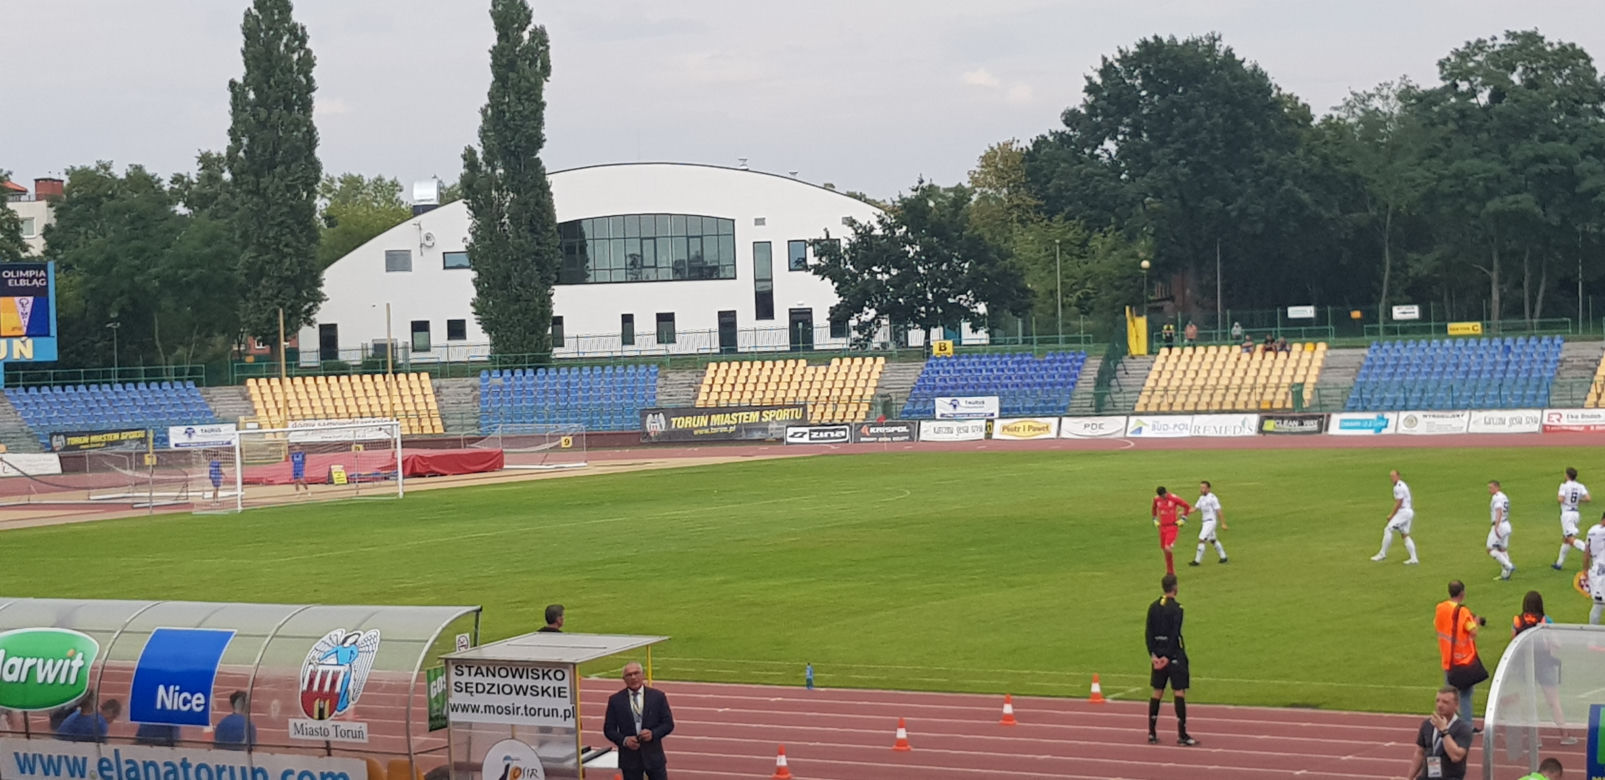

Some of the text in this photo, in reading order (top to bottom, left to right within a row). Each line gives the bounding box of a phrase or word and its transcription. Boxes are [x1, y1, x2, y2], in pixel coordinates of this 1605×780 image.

[2, 270, 46, 278] OLIMPIA
[8, 279, 47, 288] ELBLĄG
[938, 342, 947, 351] B
[710, 410, 760, 426] MIASTEM
[761, 407, 803, 421] SPORTU
[454, 664, 566, 682] STANOWISKO
[156, 684, 205, 712] Nice
[453, 681, 569, 699] SĘDZIOWSKIE
[450, 702, 576, 722] www.mosir.torun.pl
[293, 722, 365, 740] Miasto Toruń
